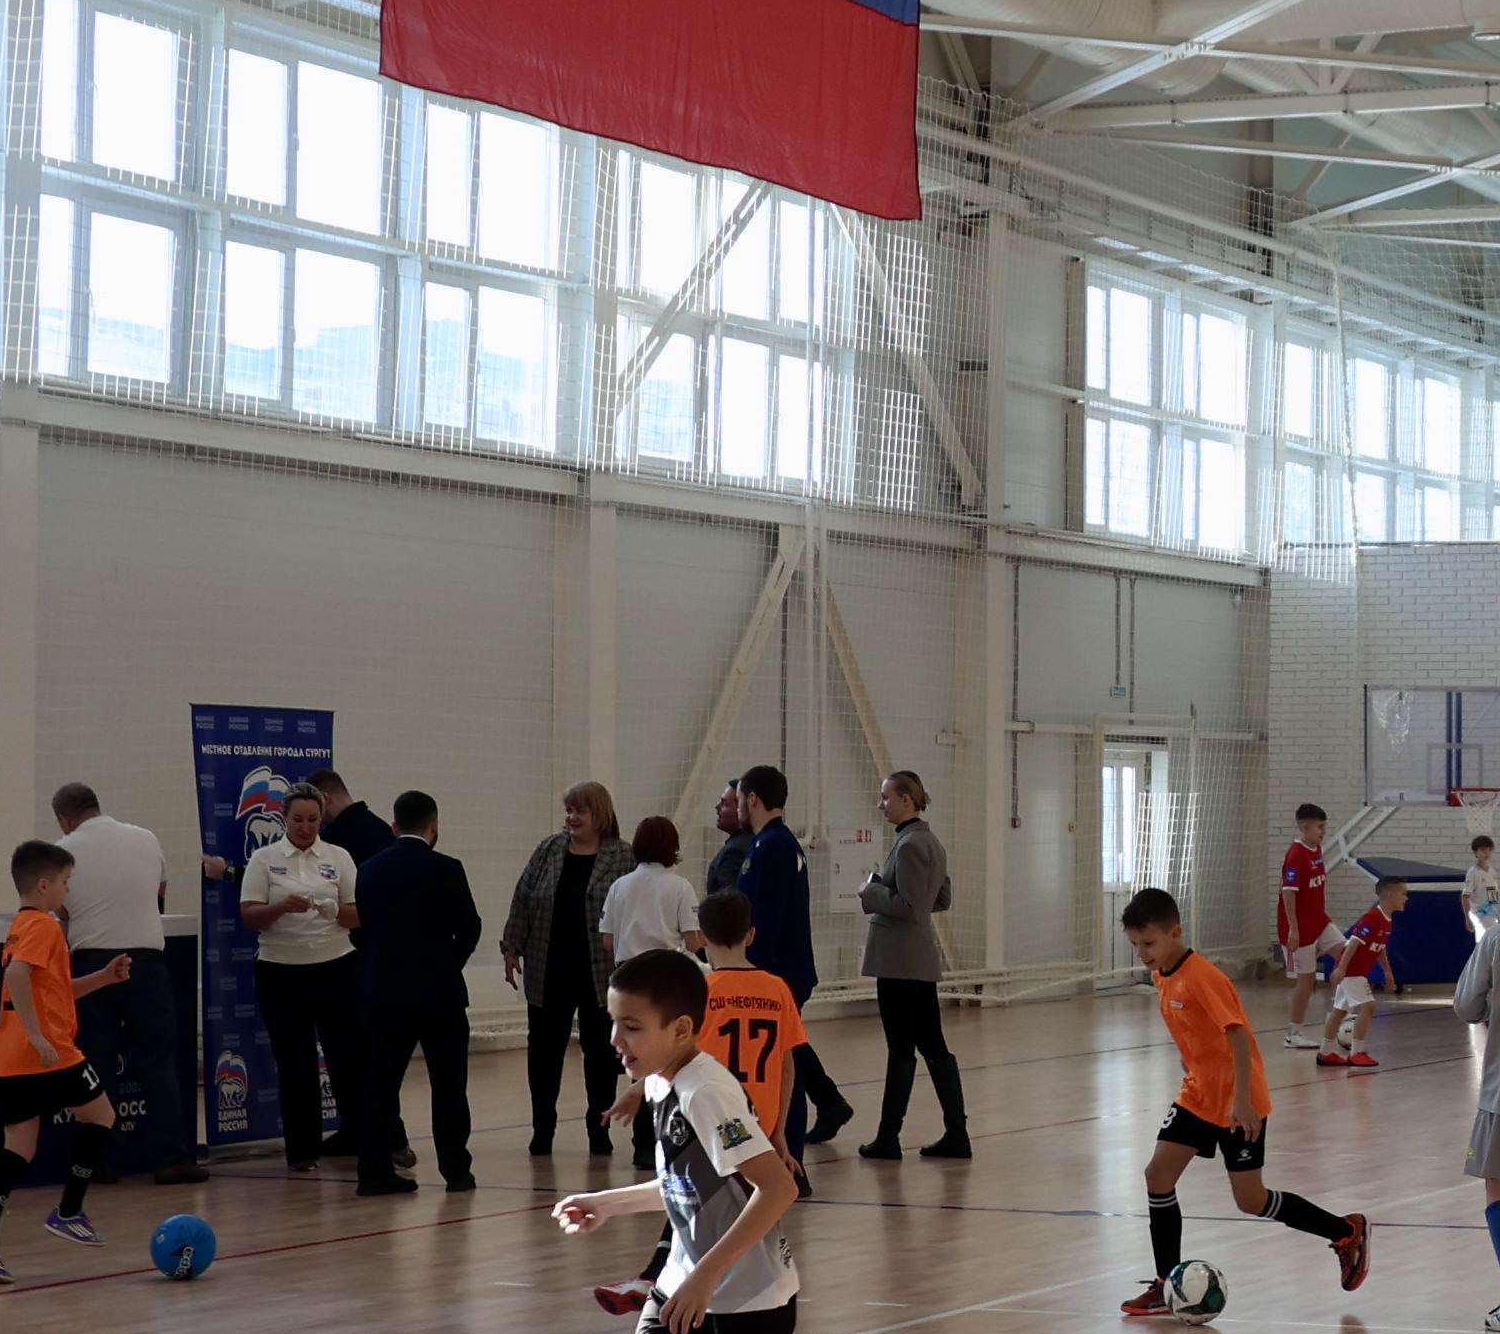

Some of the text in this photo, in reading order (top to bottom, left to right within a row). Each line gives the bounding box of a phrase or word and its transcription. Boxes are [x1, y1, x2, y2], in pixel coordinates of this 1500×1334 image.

[233, 745, 273, 756] ОТДЕЛЕНИЕ
[274, 746, 304, 758] ГОРОДА
[305, 747, 331, 759] СУРГУТ
[709, 997, 726, 1011] СШ
[718, 1018, 778, 1083] 17
[217, 1108, 248, 1121] ЕДИНАЯ
[217, 1120, 249, 1133] РОССИЯ
